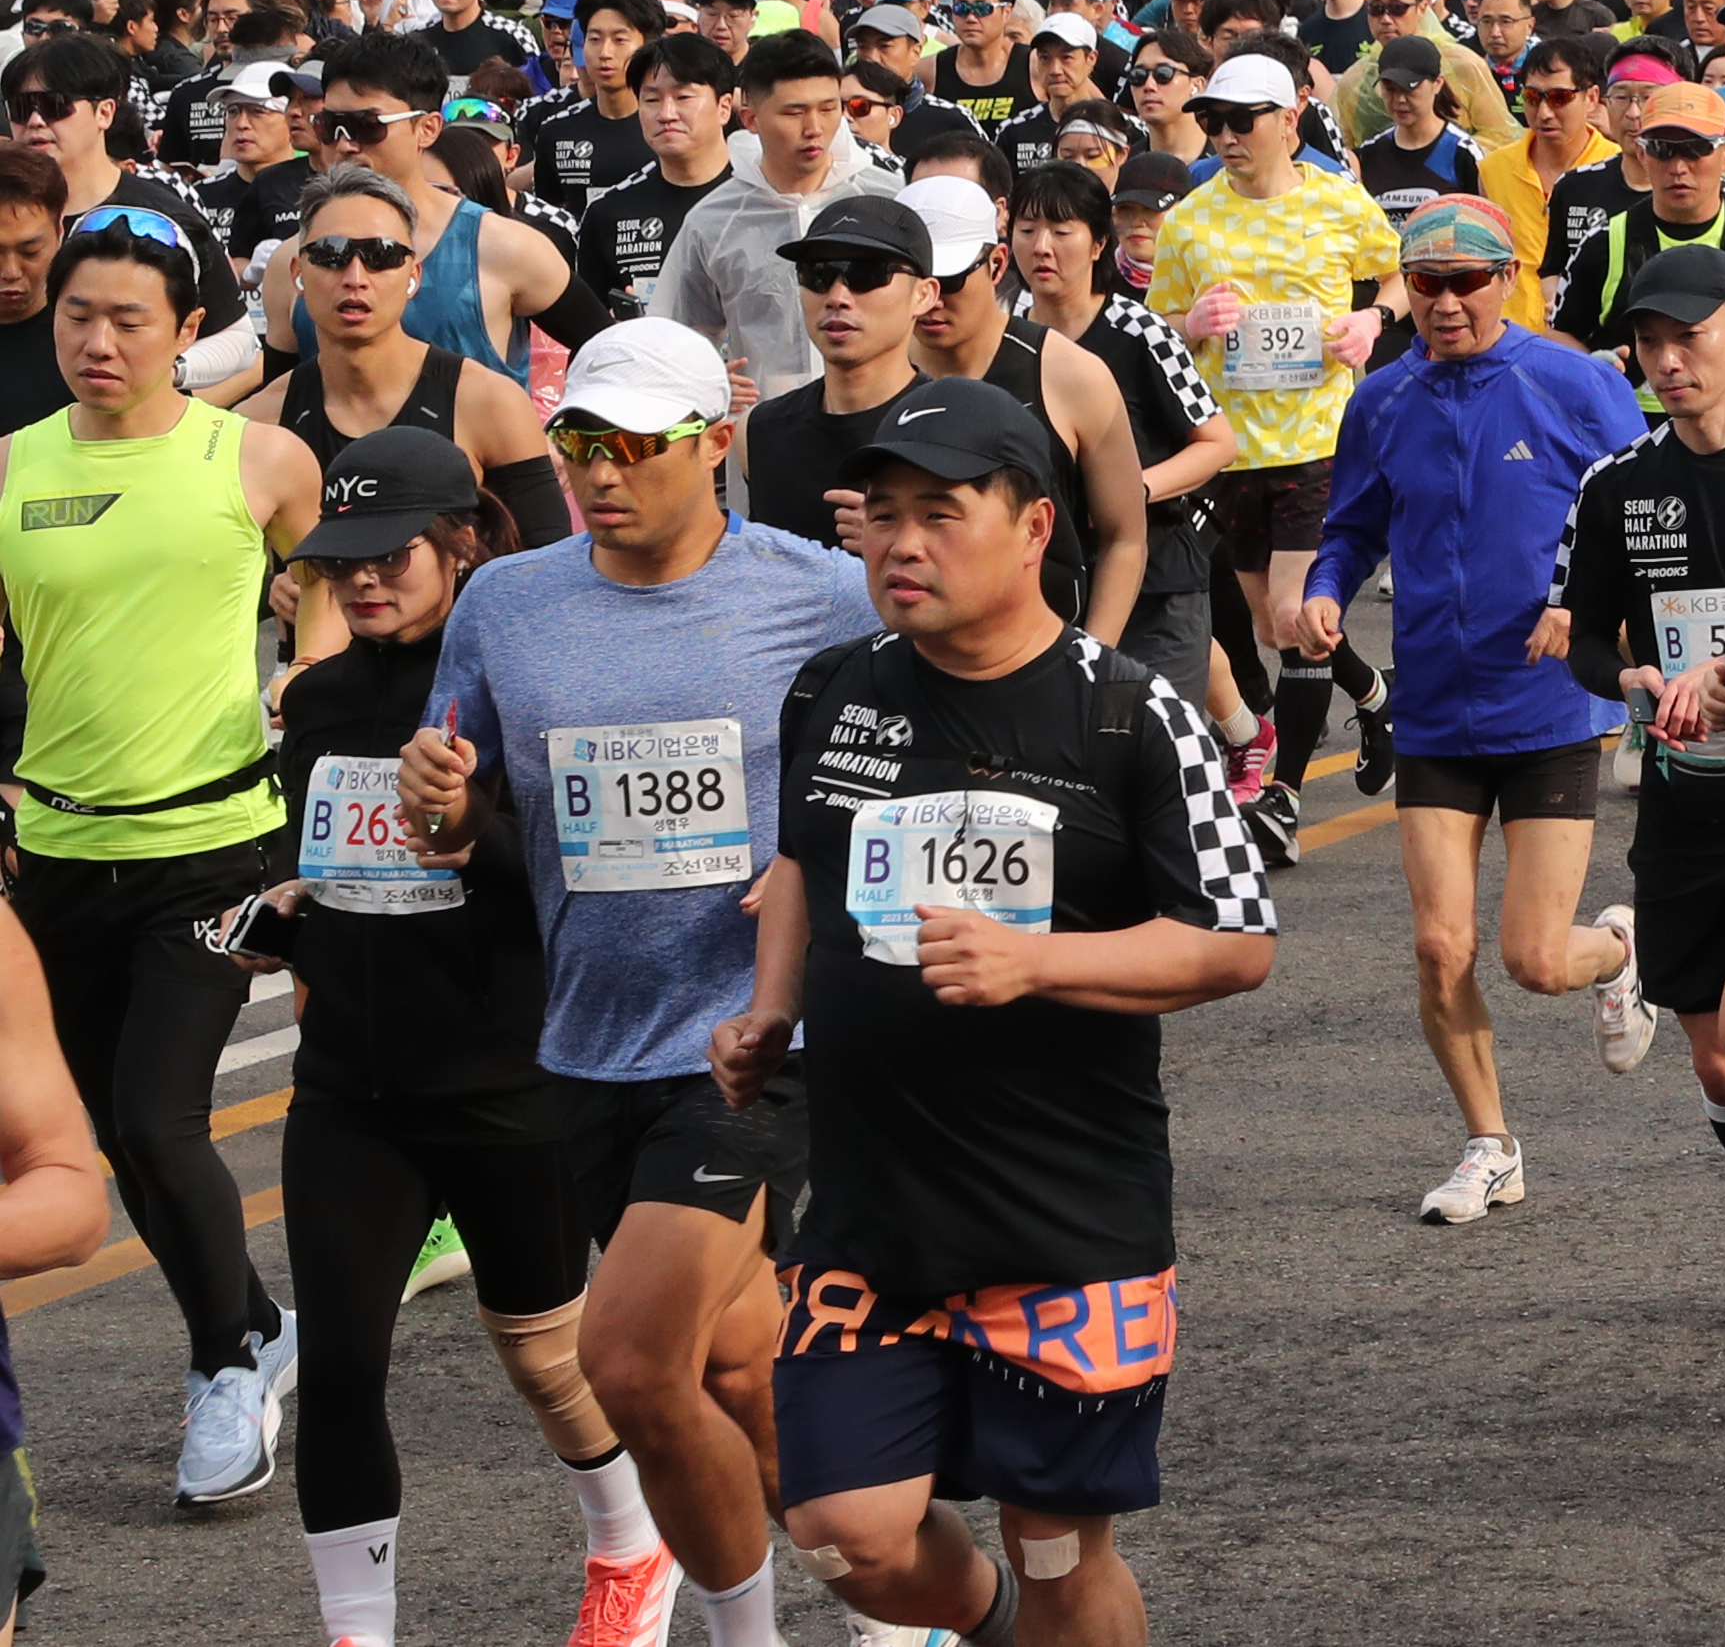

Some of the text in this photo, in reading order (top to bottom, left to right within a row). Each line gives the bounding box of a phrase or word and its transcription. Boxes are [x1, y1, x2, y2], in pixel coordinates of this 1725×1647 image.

[616, 241, 662, 255] MARATHON
[617, 231, 638, 244] HALF
[1225, 326, 1305, 352] B 392
[202, 428, 221, 461] Reebok
[325, 474, 378, 503] NYC
[25, 495, 96, 526] RUN
[1624, 499, 1656, 515] SEOUL
[1624, 516, 1653, 533] HALF
[1625, 533, 1688, 551] MARATHON
[1647, 566, 1689, 578] BROOKS
[1664, 626, 1683, 659] B
[839, 703, 879, 731] SEOUL
[603, 733, 720, 763] IBK기업은행
[818, 749, 903, 783] MARATHON
[566, 766, 726, 819] B 1388
[311, 799, 332, 842] B
[911, 801, 1033, 826] IBK기업은행
[562, 821, 598, 835] HALF
[304, 844, 333, 858] HALF
[863, 836, 1030, 885] B 1626
[660, 854, 744, 878] 조선일보
[381, 886, 457, 904] 조선일보
[854, 887, 895, 903] HALF
